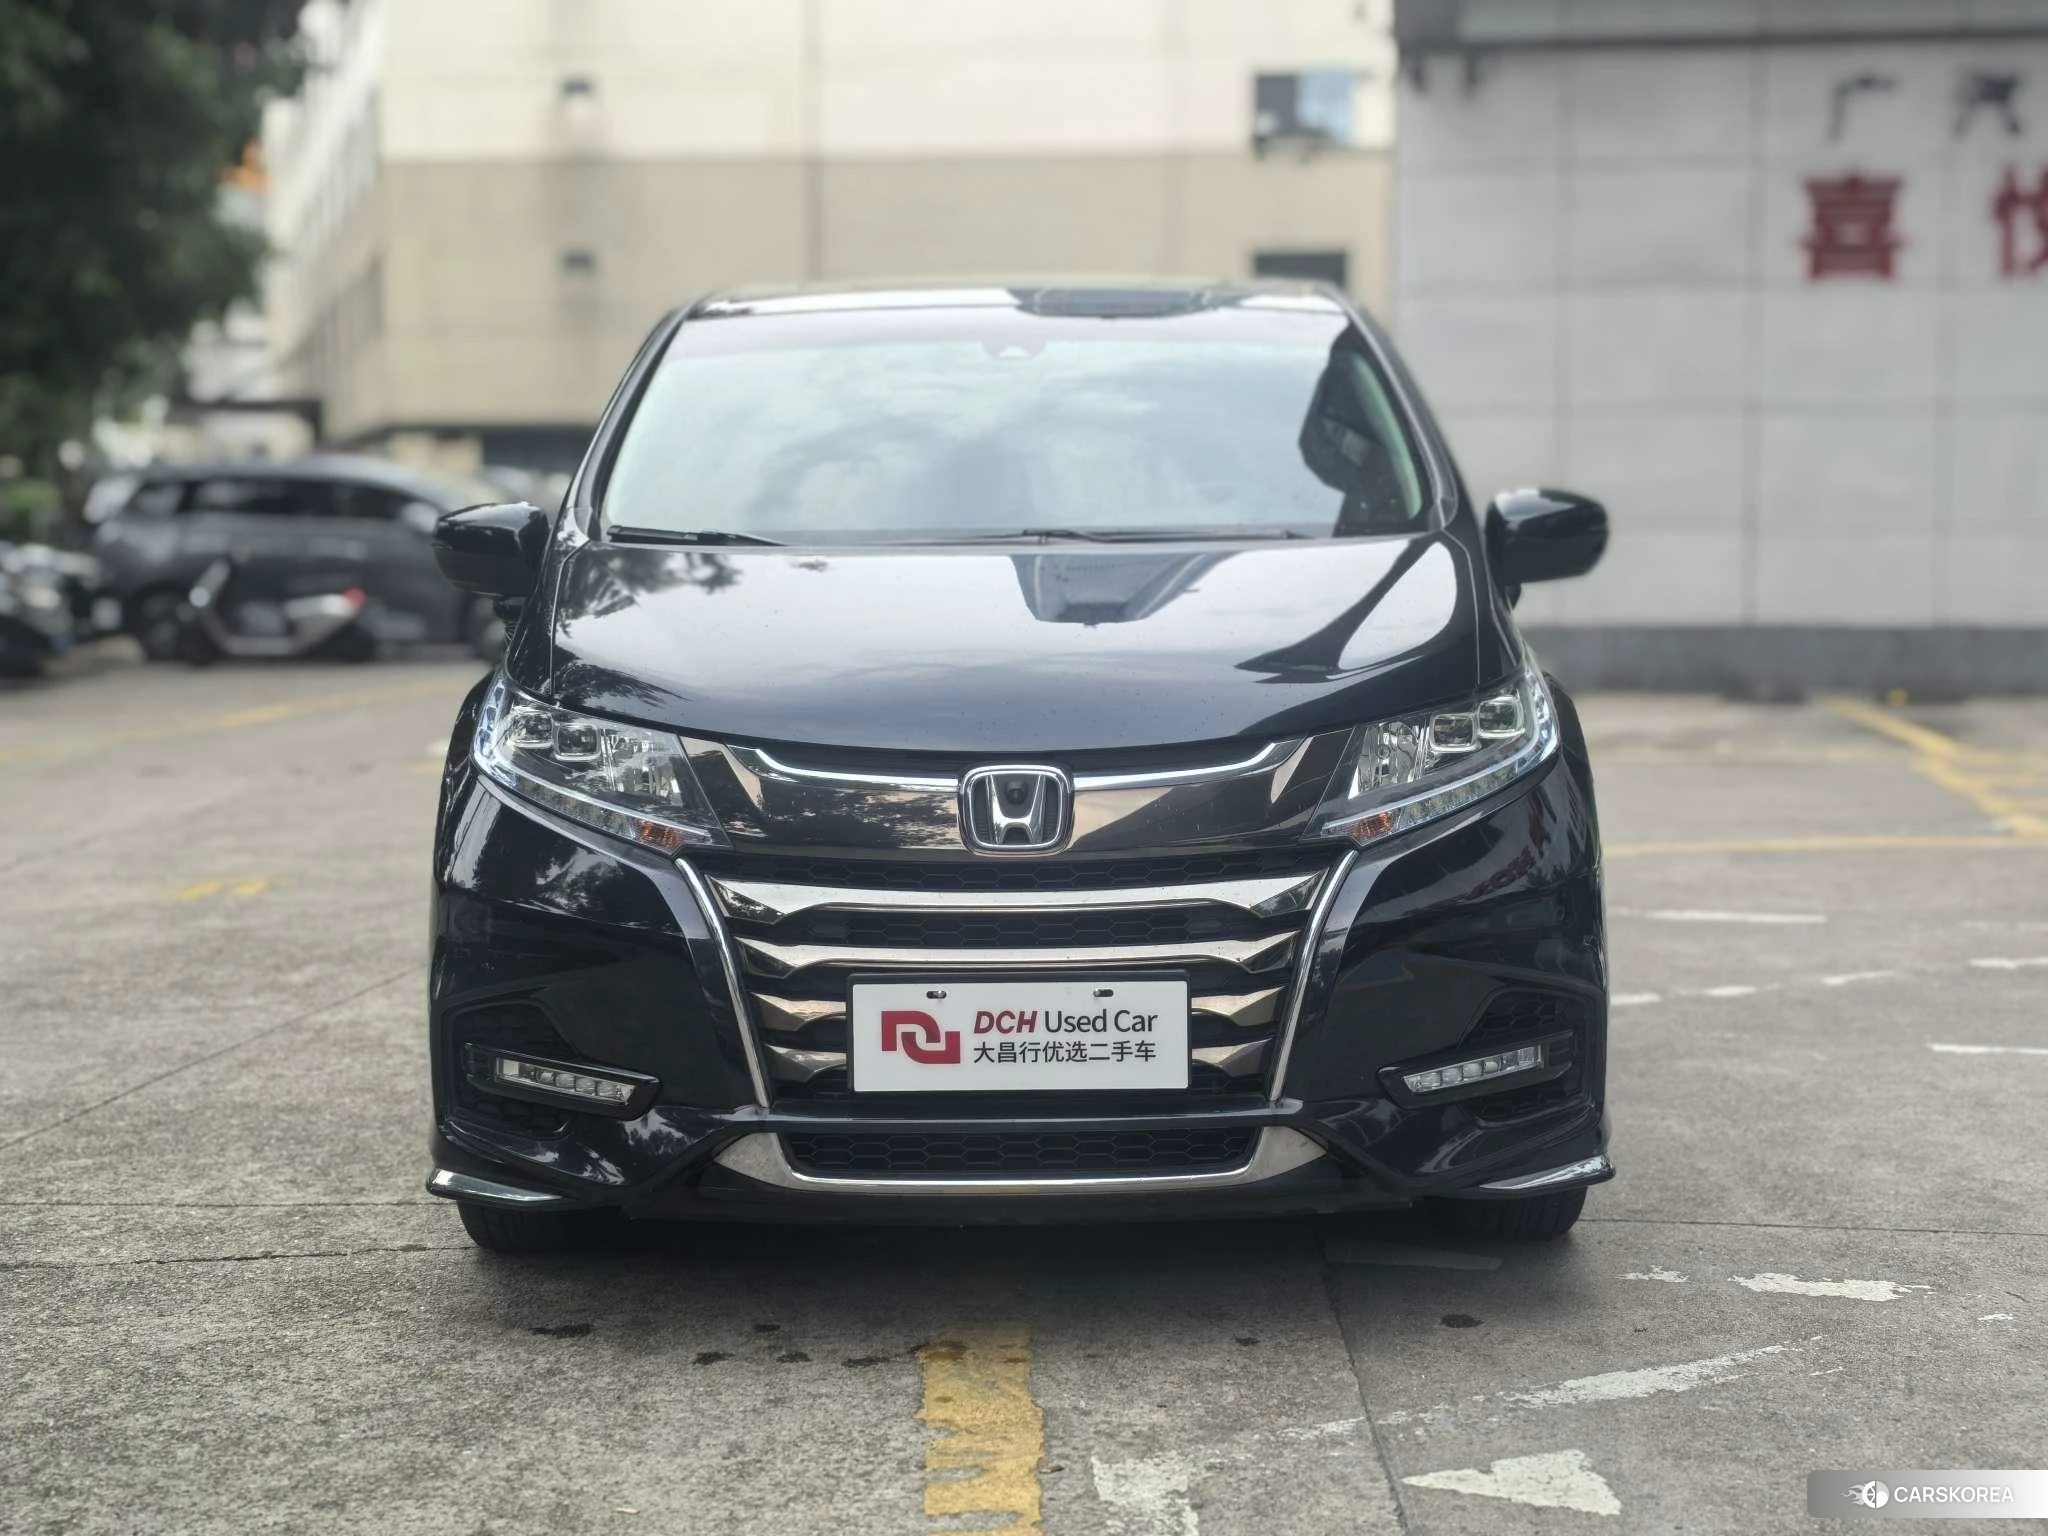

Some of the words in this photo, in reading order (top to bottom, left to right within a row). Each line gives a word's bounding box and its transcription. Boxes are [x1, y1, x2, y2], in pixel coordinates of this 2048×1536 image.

[973, 1010, 1038, 1034] DCH
[1044, 1008, 1107, 1033] Used
[1114, 1009, 1158, 1033] Car
[973, 1041, 1157, 1064] 大昌行优选二手车
